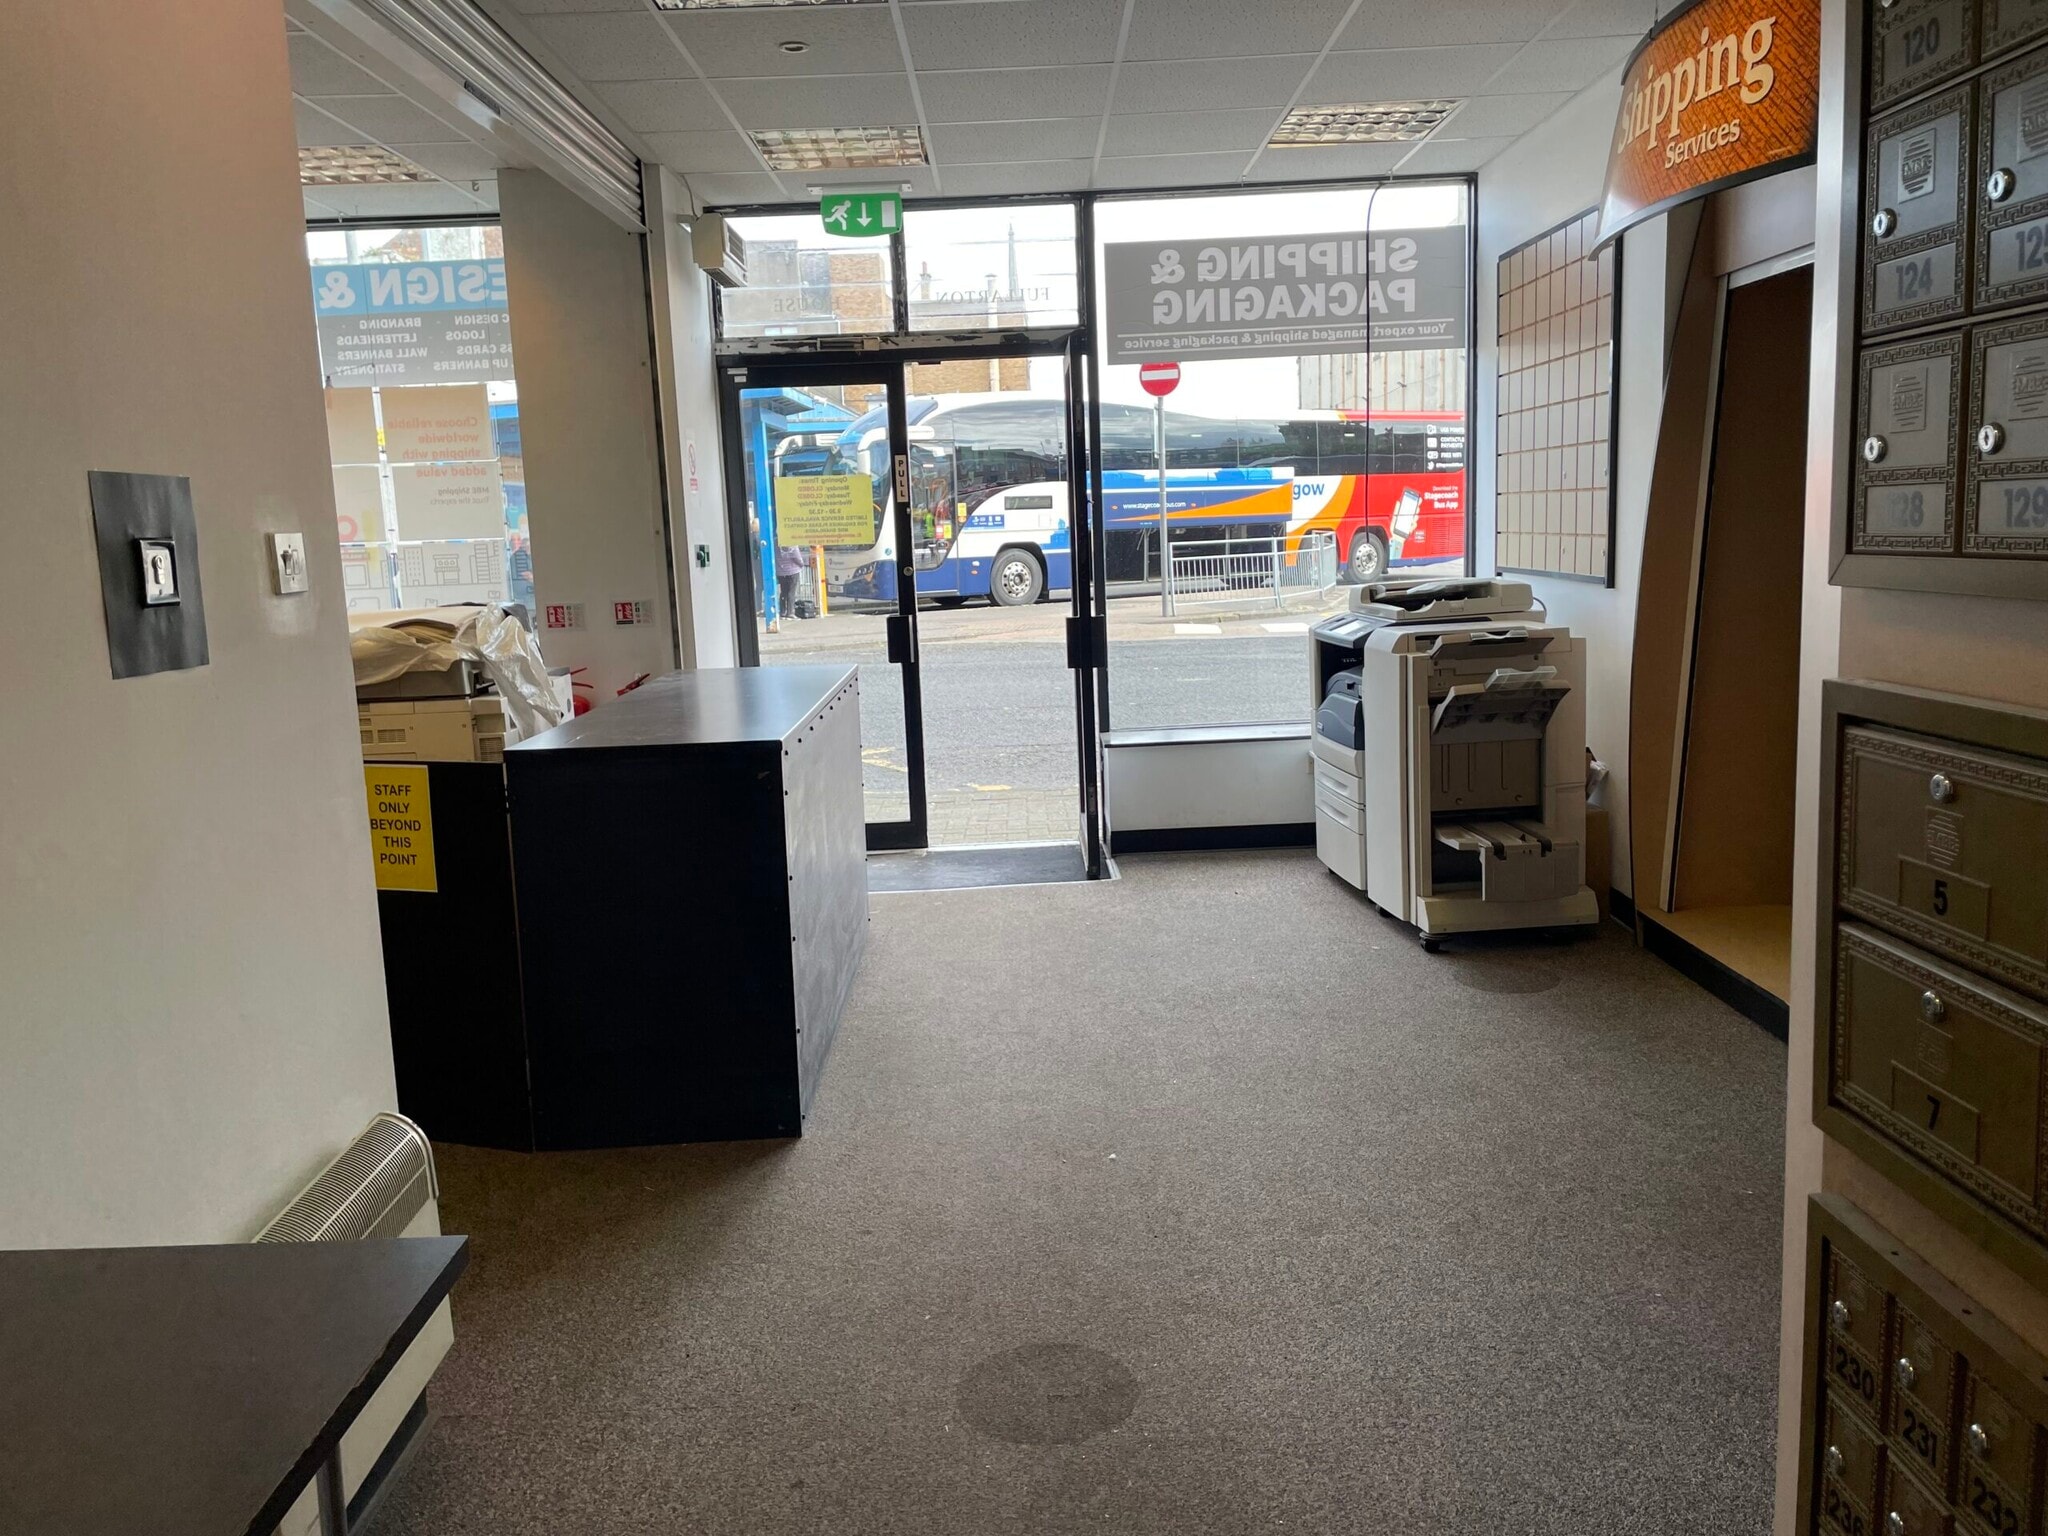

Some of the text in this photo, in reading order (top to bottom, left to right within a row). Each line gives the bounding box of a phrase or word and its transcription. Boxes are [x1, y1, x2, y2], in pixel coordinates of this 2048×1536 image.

[1903, 16, 1940, 68] 120
[1617, 16, 1776, 154] Shipping
[1664, 118, 1741, 169] Services
[1895, 257, 1933, 299] 124
[898, 459, 906, 499] PULL
[2004, 486, 2048, 529] 129
[374, 784, 412, 796] STAFF
[378, 801, 410, 814] ONLY
[370, 819, 421, 831] BEYOND
[383, 836, 412, 848] THIS
[380, 853, 417, 866] POINT
[1933, 878, 1949, 916] 5
[1926, 1092, 1941, 1131] 7
[1835, 1343, 1876, 1401] 230
[1902, 1407, 1938, 1468] 231
